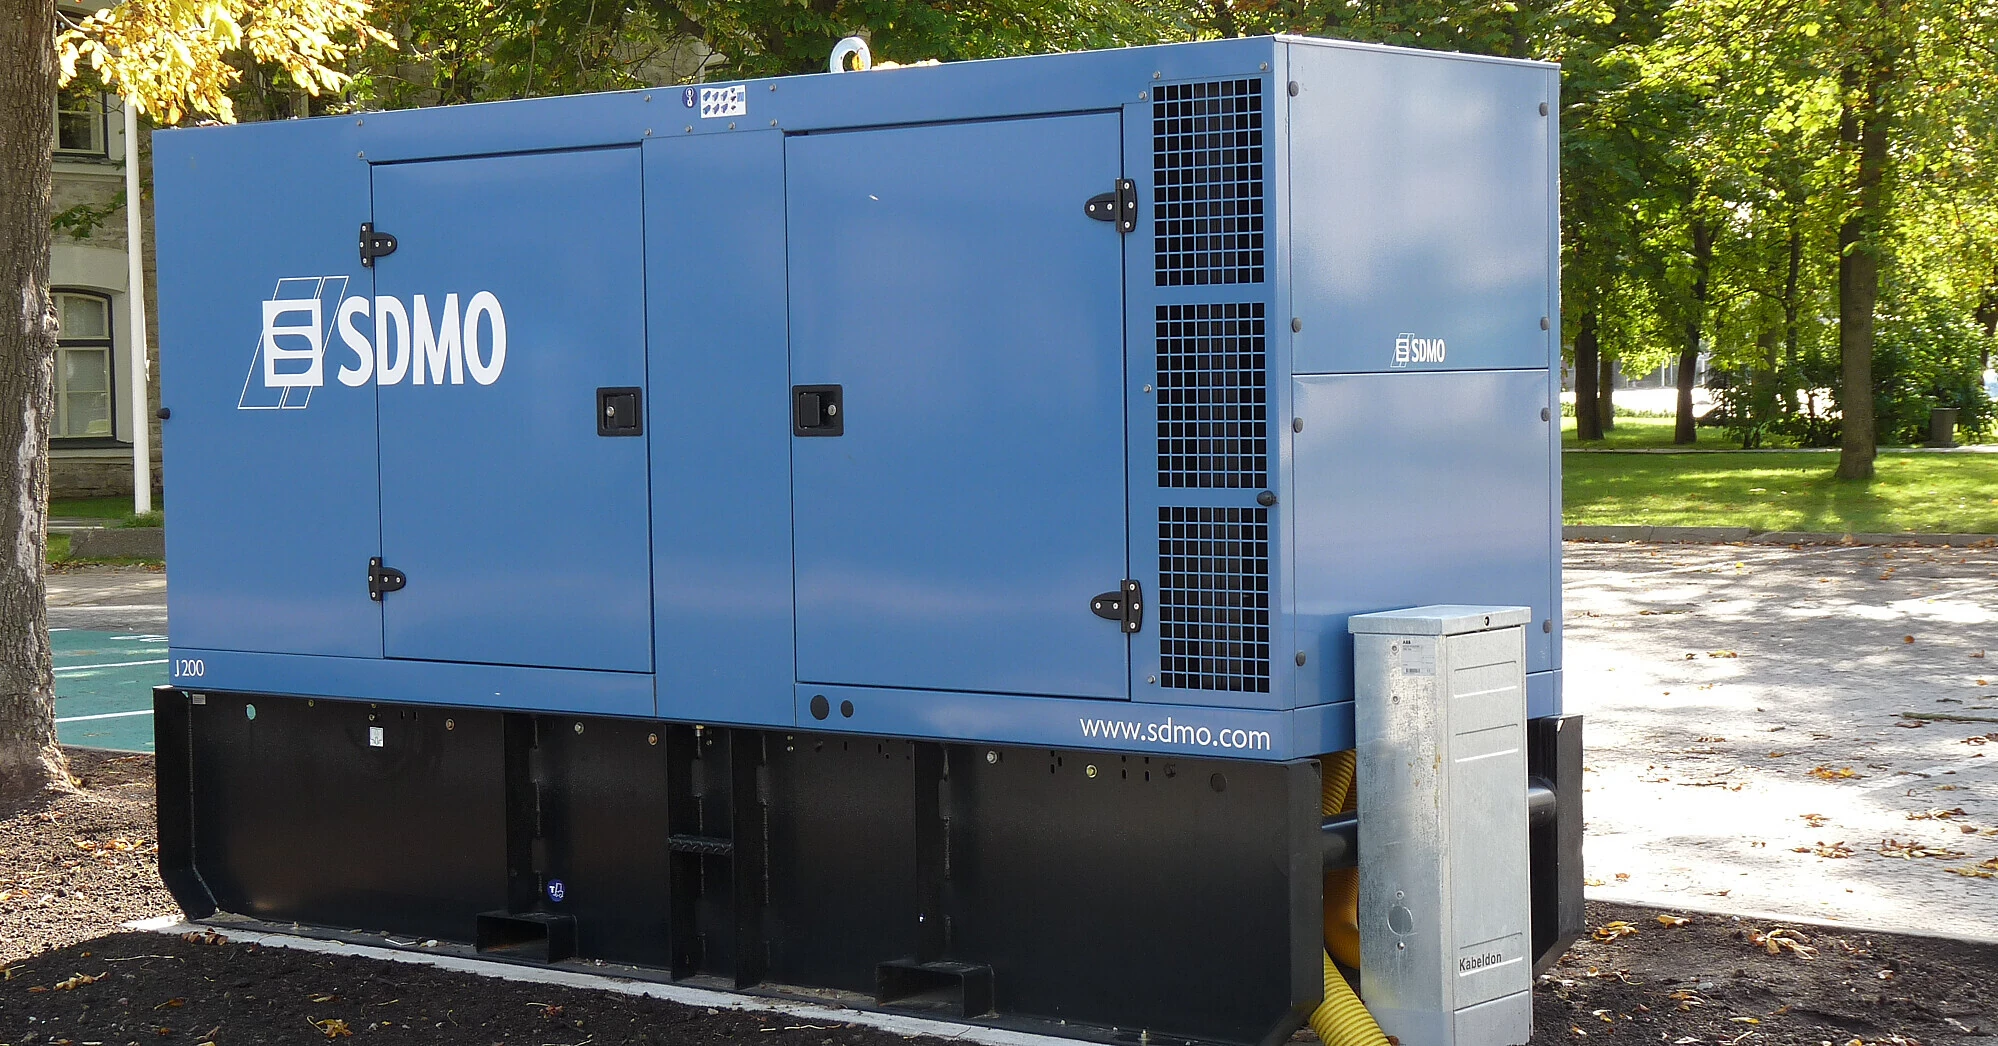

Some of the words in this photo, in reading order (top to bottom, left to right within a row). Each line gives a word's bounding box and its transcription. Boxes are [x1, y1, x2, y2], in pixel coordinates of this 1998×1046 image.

[337, 290, 507, 387] SDMO
[1411, 338, 1445, 362] SDMO
[1079, 716, 1271, 750] www.sdmo.com
[1459, 953, 1502, 971] Kabeldon
